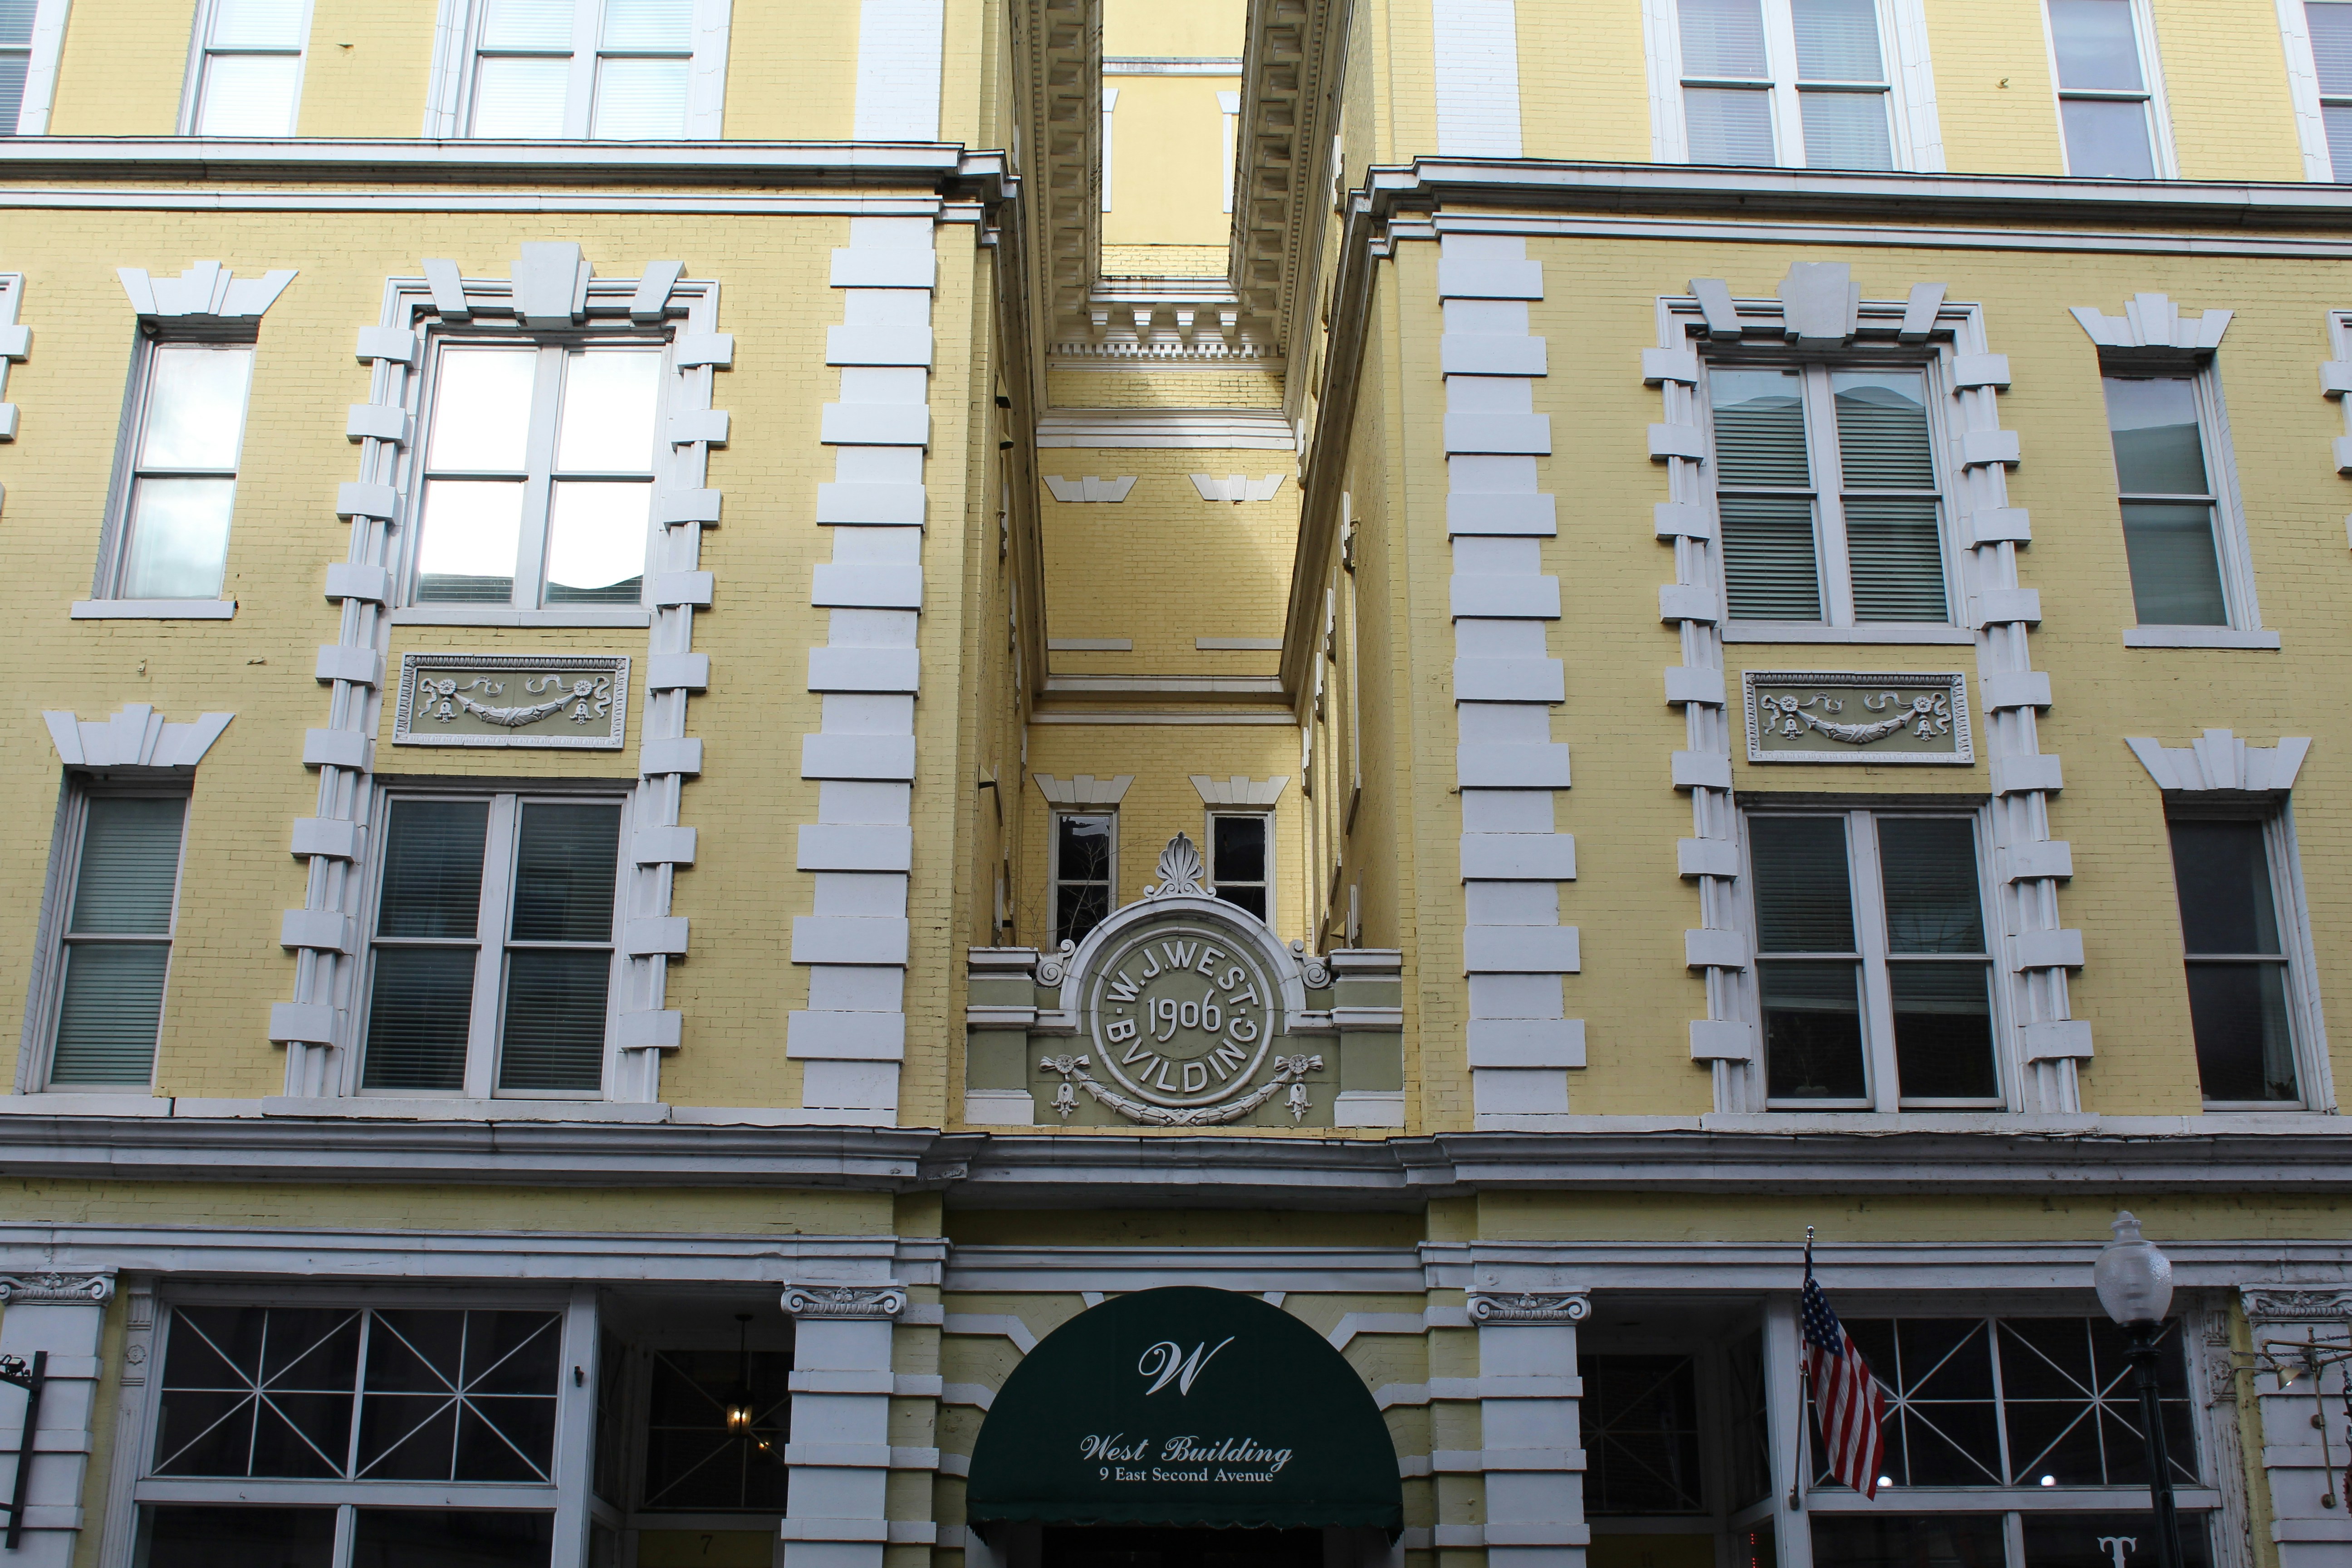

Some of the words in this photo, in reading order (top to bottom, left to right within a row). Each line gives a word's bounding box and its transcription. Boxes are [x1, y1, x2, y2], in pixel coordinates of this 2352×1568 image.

[1147, 988, 1221, 1042] 1906
[1138, 1336, 1235, 1396] W
[1080, 1433, 1149, 1461] West
[1161, 1436, 1293, 1472] Building
[1099, 1467, 1109, 1481] 9
[1115, 1467, 1147, 1481] East
[1152, 1467, 1209, 1482] Second
[1214, 1468, 1274, 1482] Avenue
[700, 1534, 713, 1554] 7
